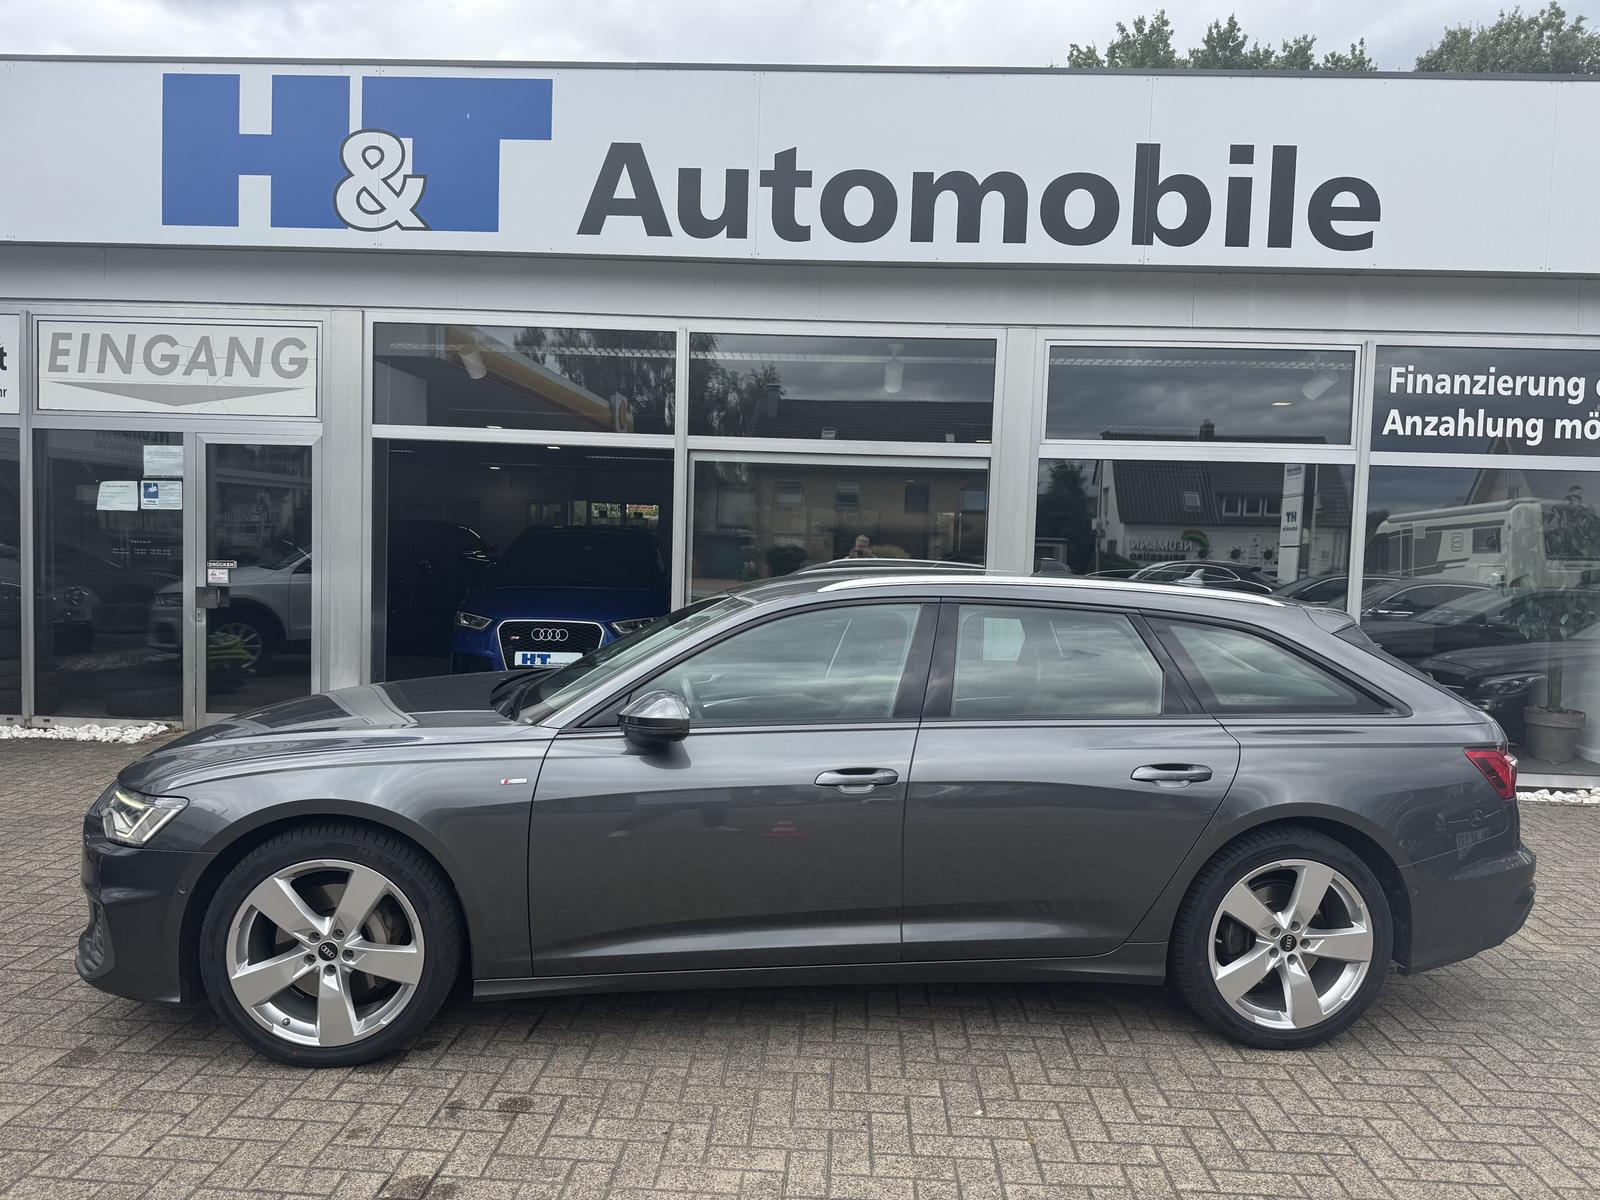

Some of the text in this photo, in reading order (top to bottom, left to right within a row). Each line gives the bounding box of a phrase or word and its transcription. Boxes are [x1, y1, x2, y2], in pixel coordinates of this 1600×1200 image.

[162, 73, 1381, 251] H&T Automobile
[48, 332, 309, 379] EINGANG
[1390, 365, 1586, 405] Finanzierung
[1382, 408, 1544, 446] Anzahlung
[522, 653, 551, 665] H&T
